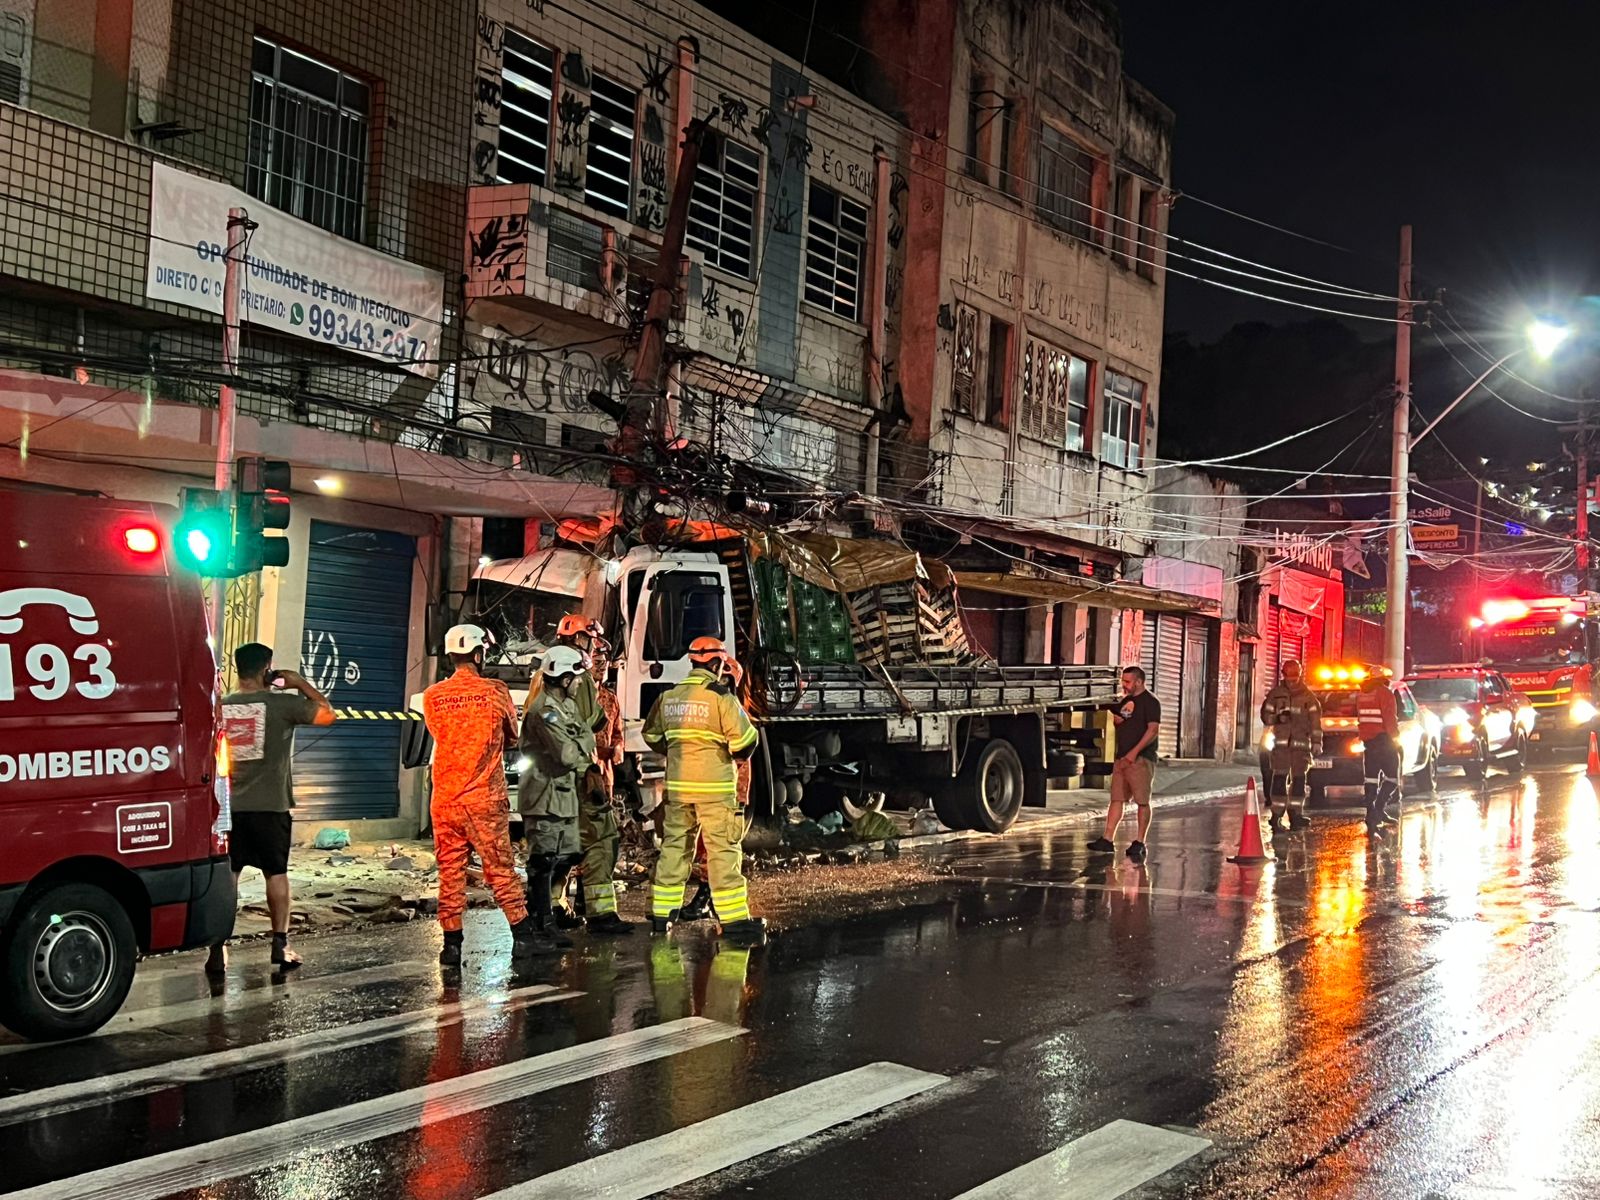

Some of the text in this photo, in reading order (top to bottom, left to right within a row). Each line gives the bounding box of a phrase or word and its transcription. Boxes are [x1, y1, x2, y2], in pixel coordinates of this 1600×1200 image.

[156, 266, 198, 292] DIRETO
[312, 279, 327, 301] DE
[332, 286, 358, 311] BOM
[360, 298, 410, 329] NEGÓCIO
[0, 643, 116, 700] 193
[664, 703, 710, 718] BOMBEIROS
[0, 745, 170, 782] OMBEIROS
